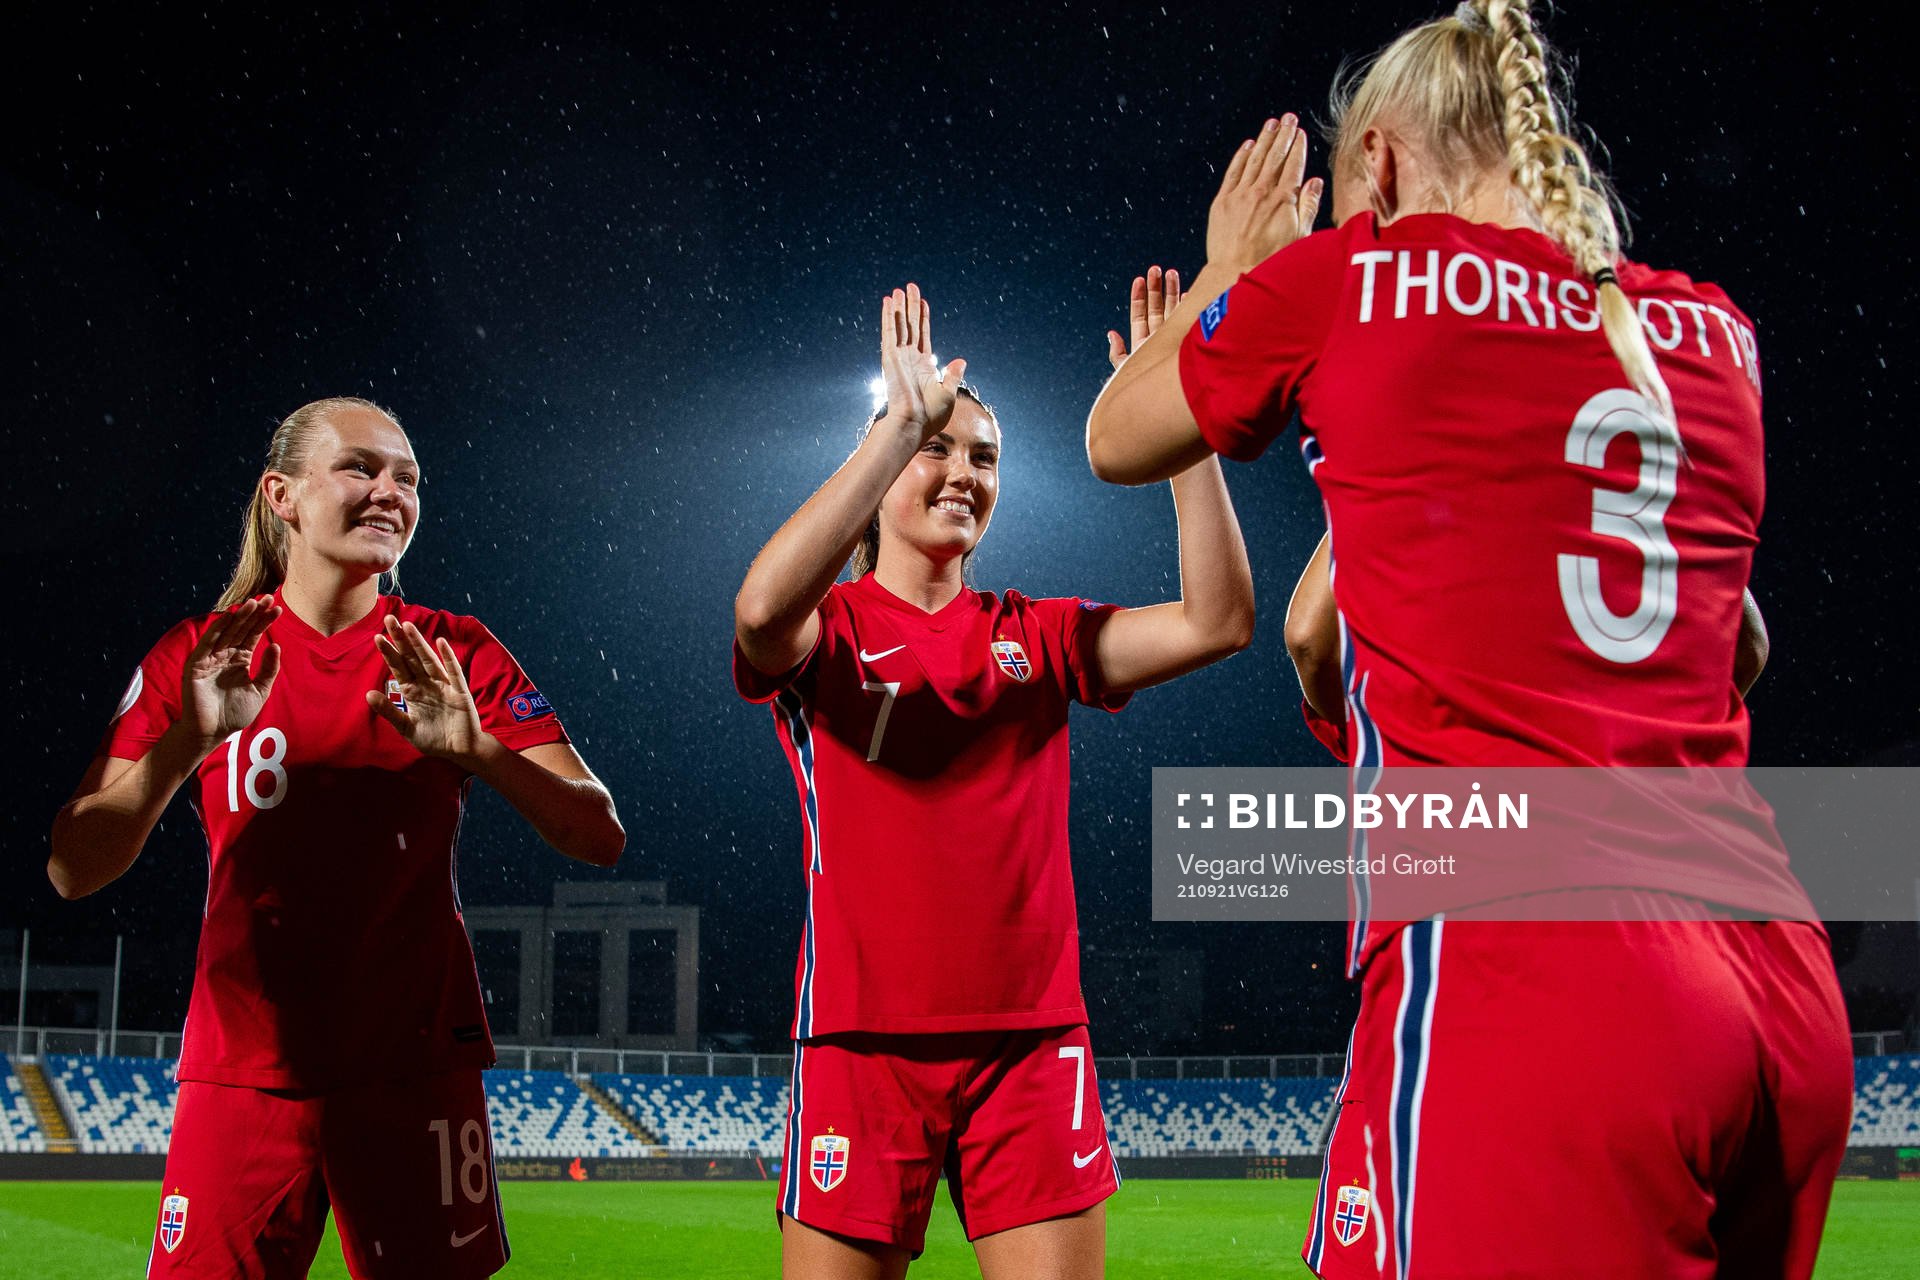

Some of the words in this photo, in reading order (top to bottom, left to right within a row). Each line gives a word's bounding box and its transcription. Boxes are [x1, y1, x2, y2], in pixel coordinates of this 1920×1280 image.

[1351, 250, 1761, 396] THORISOTTIR
[1557, 388, 1678, 664] 3
[862, 681, 901, 762] 7
[225, 727, 288, 812] 18
[1058, 1046, 1084, 1130] 7
[428, 1119, 488, 1205] 18
